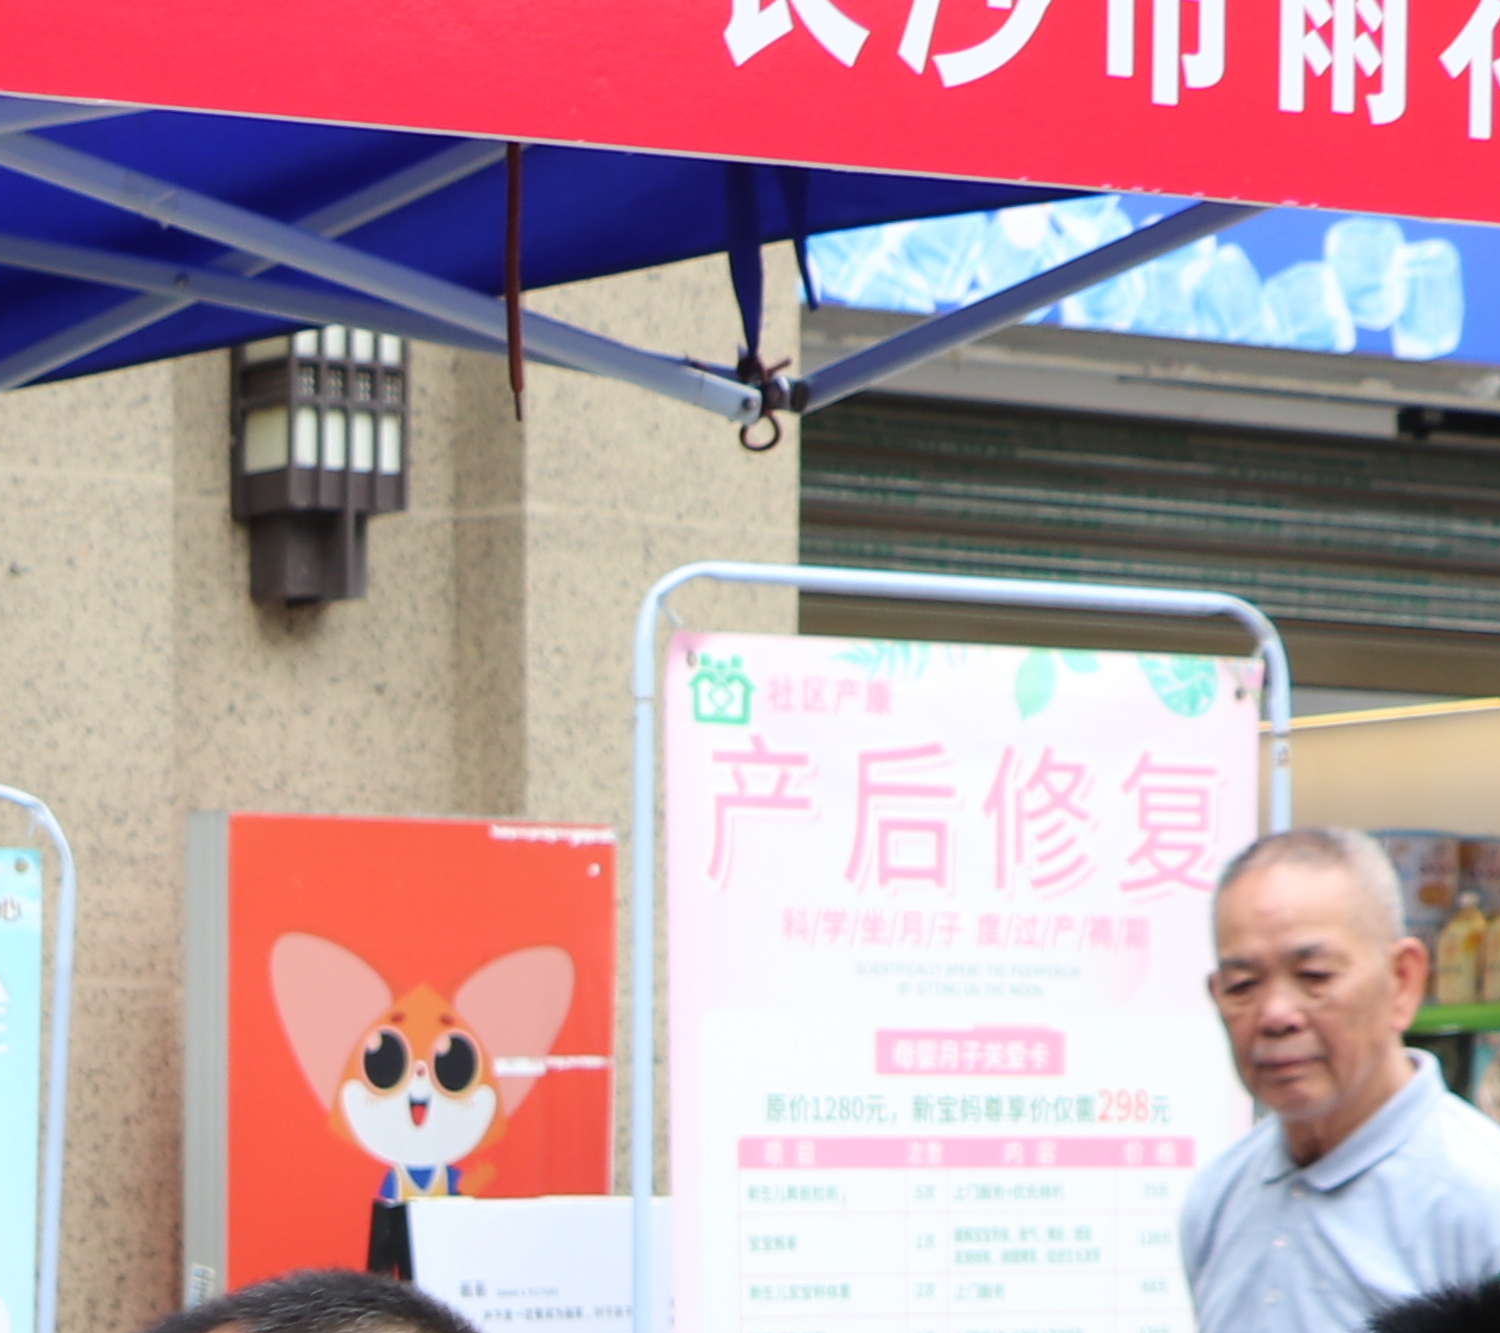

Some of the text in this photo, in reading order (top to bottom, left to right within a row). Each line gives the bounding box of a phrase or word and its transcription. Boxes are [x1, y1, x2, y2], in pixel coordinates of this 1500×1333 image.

[768, 675, 893, 716] 社区产康
[707, 733, 1222, 898] 产后修复
